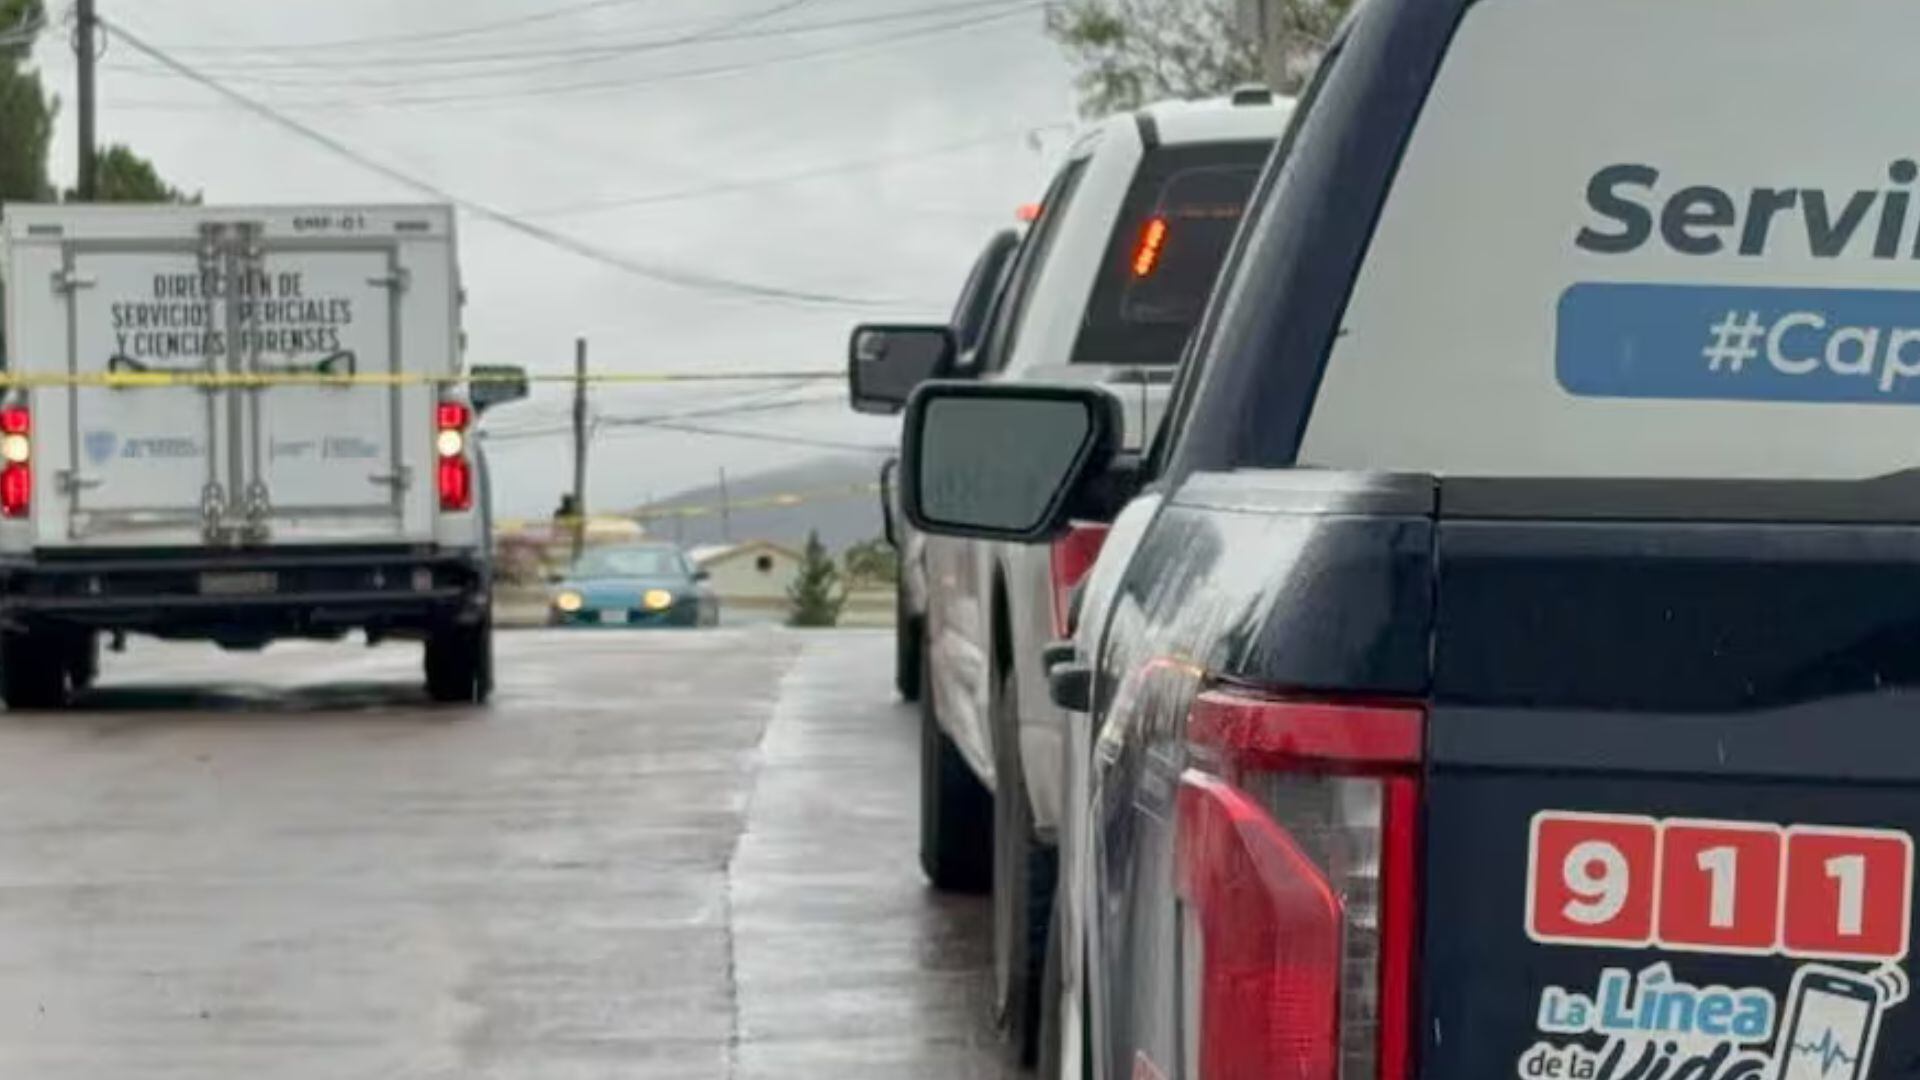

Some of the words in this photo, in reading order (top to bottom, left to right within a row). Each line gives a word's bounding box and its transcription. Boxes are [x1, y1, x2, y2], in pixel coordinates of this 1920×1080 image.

[1575, 158, 1920, 259] Servi
[279, 272, 303, 298] DE
[116, 332, 128, 355] Y
[1702, 310, 1920, 392] #Cap
[1561, 839, 1867, 937] 911
[1547, 993, 1586, 1028] La
[1602, 970, 1769, 1036] Línea
[1527, 1050, 1562, 1077] de
[1570, 1052, 1595, 1080] la
